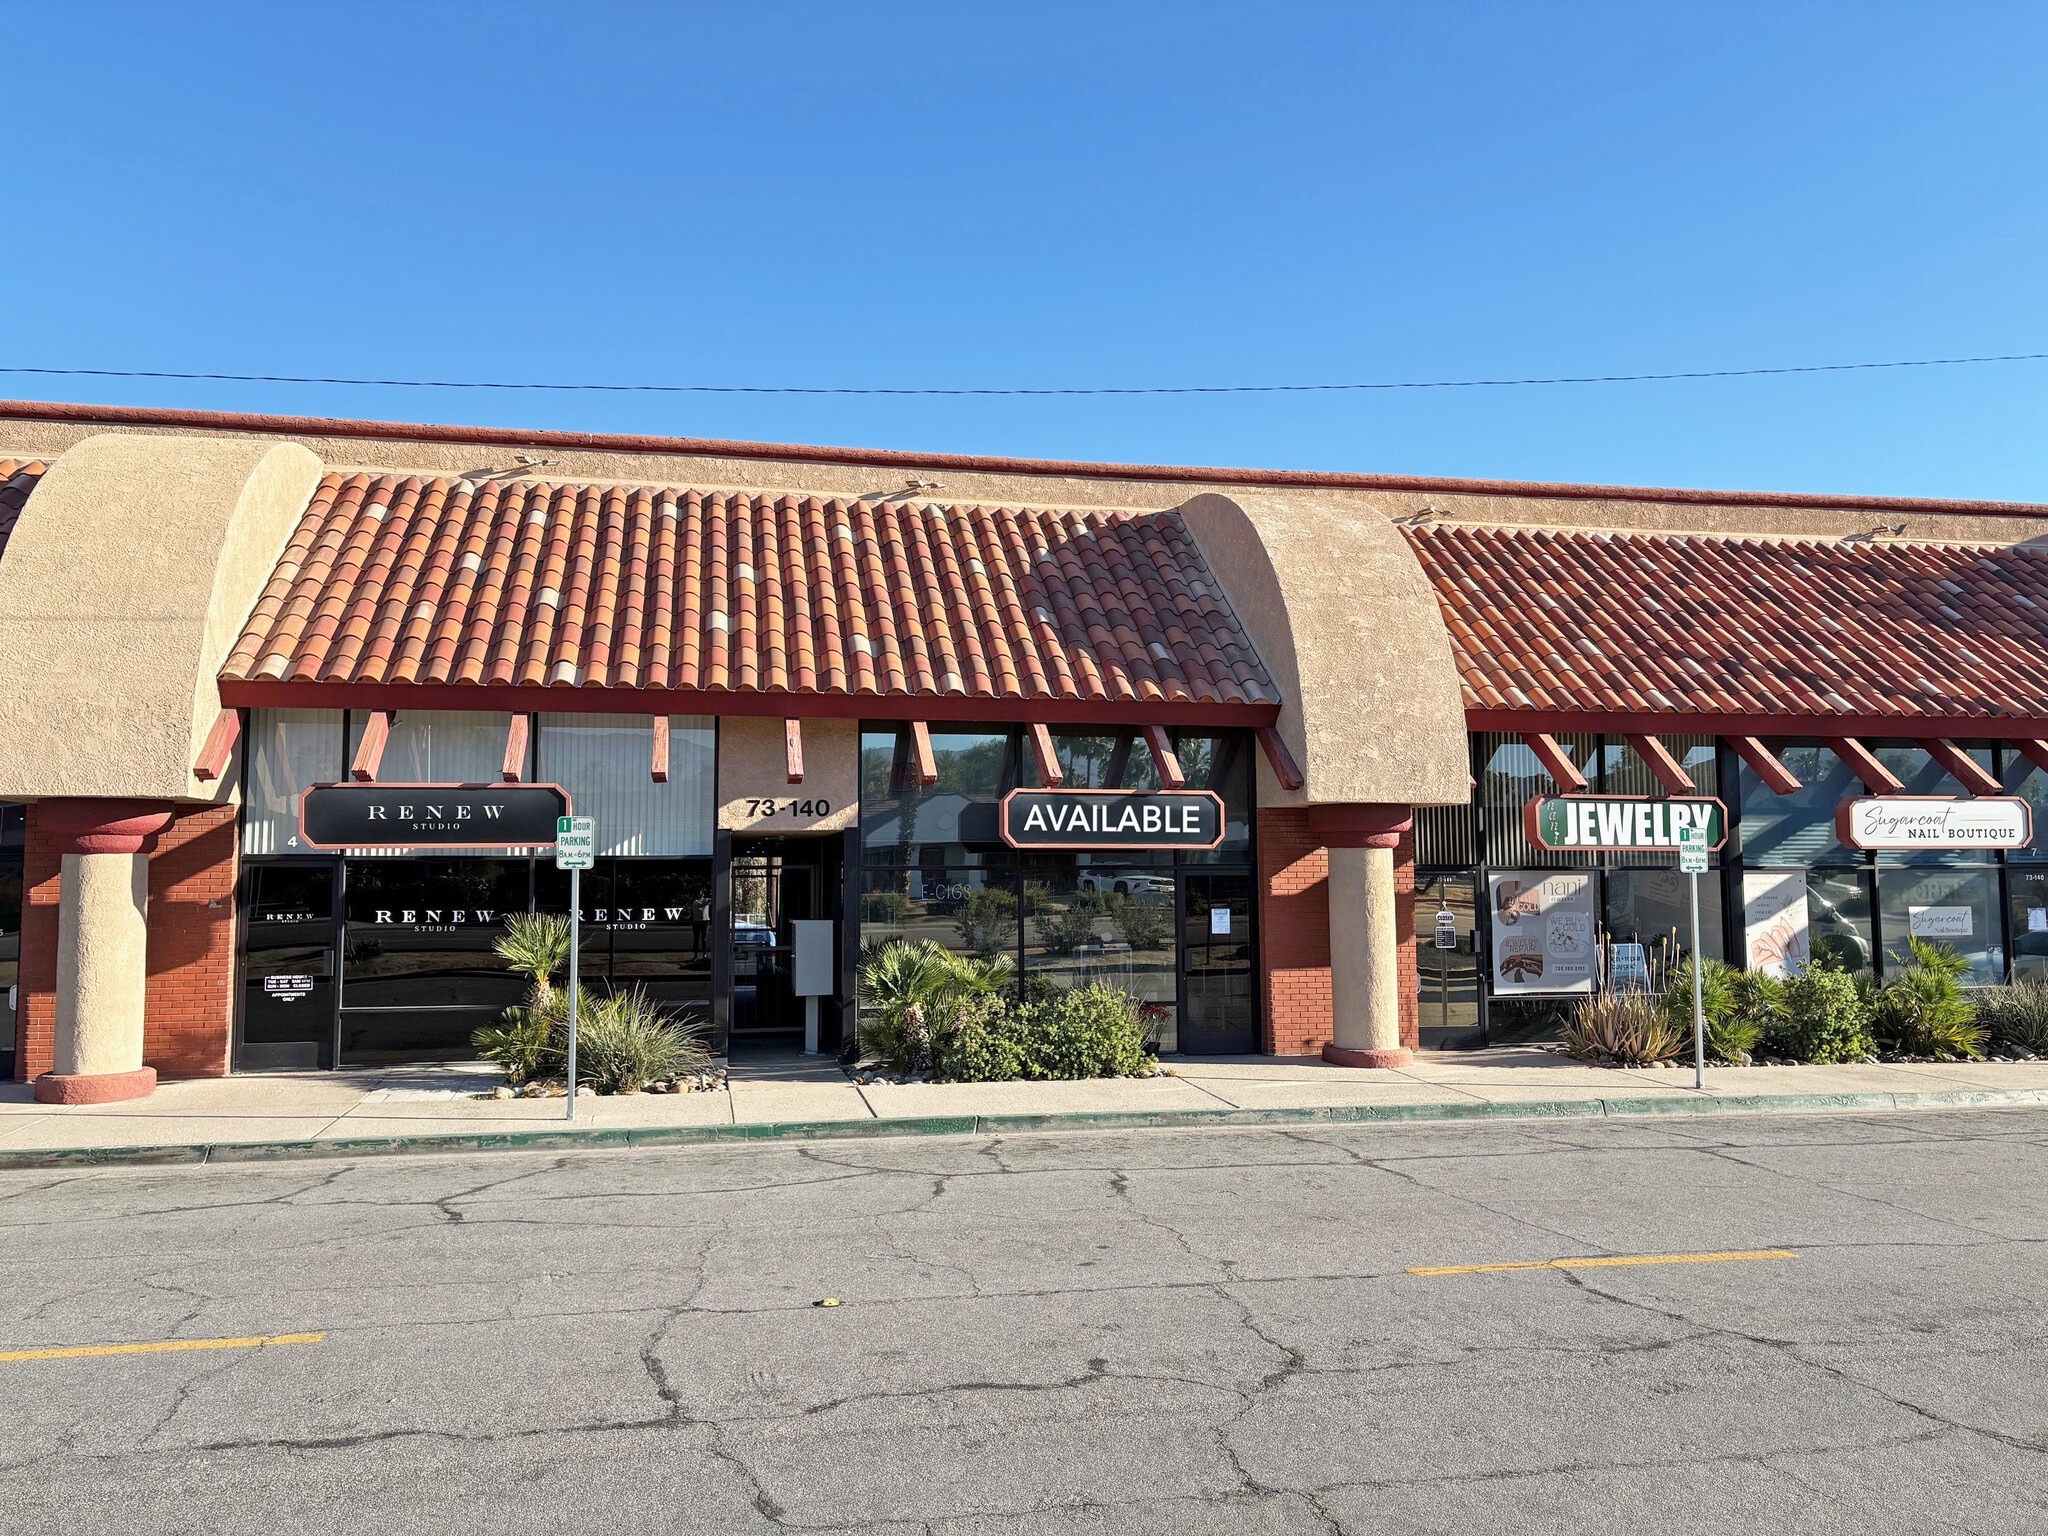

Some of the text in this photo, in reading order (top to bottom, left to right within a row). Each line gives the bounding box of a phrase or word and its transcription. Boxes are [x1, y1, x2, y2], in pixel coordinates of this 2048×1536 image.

[368, 805, 505, 820] RENEW
[746, 800, 830, 818] 73-140
[563, 820, 590, 831] 1 HOUR
[1023, 804, 1201, 834] AVAILABLE
[1546, 802, 1560, 845] nani
[1564, 802, 1712, 846] JEWELRY
[1864, 806, 1956, 835] Sugarcoat
[1683, 830, 1687, 840] 1
[1908, 828, 2015, 839] NAIL BOUTIQUE
[288, 836, 298, 848] 4
[560, 836, 590, 846] PARKING
[1682, 844, 1705, 853] PARKING
[2031, 848, 2038, 857] 7
[921, 884, 972, 900] E-CIGS
[1543, 878, 1581, 896] nani
[375, 910, 494, 924] RENEW
[1550, 917, 1563, 925] WE
[1912, 910, 1970, 929] Sugarcoat
[1505, 939, 1538, 947] JEWELRY
